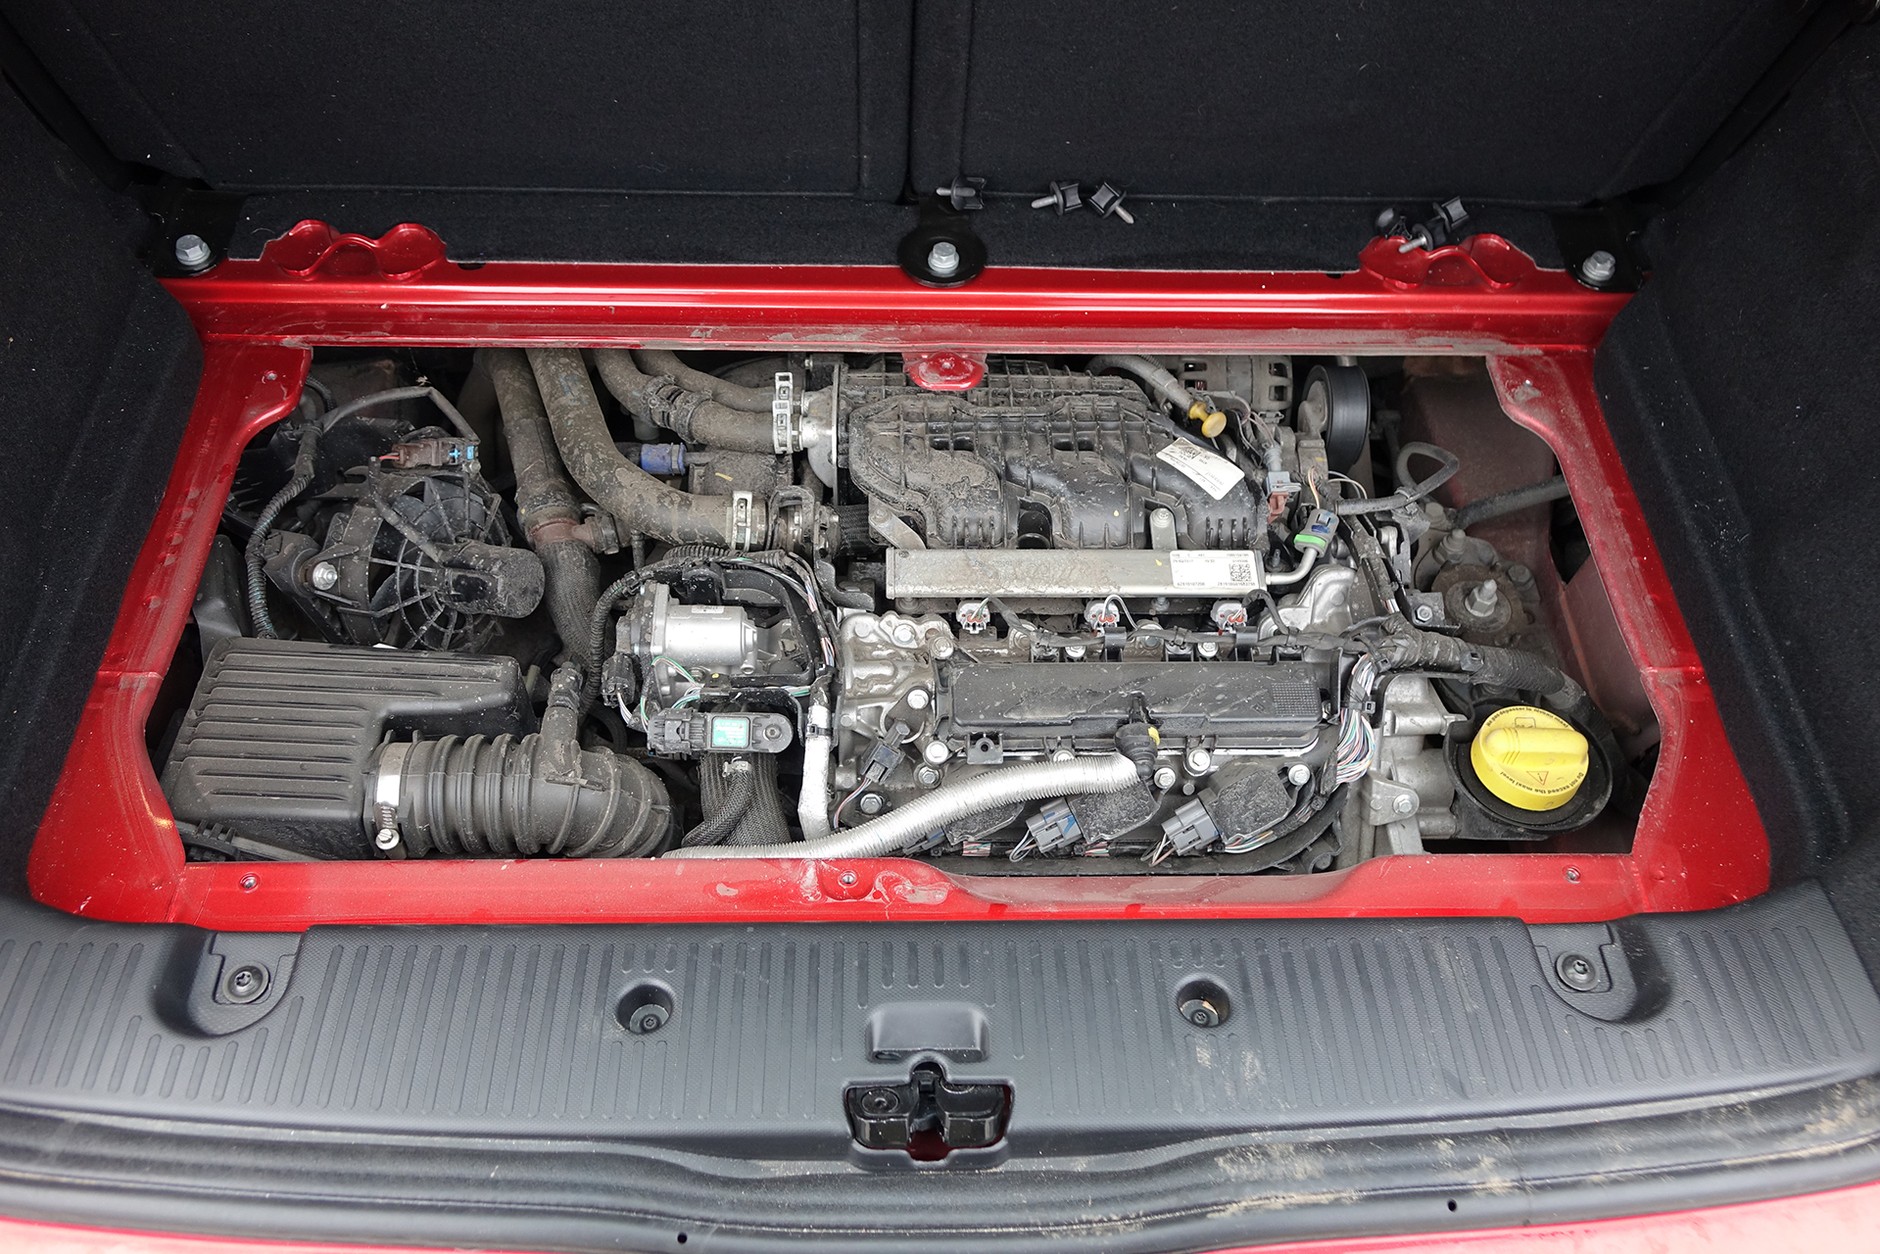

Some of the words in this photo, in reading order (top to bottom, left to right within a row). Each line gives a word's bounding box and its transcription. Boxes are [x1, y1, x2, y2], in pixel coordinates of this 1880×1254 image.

[1500, 771, 1515, 783] level
[1515, 782, 1533, 791] maxi
[1569, 779, 1578, 787] not
[1547, 785, 1570, 794] exceed
